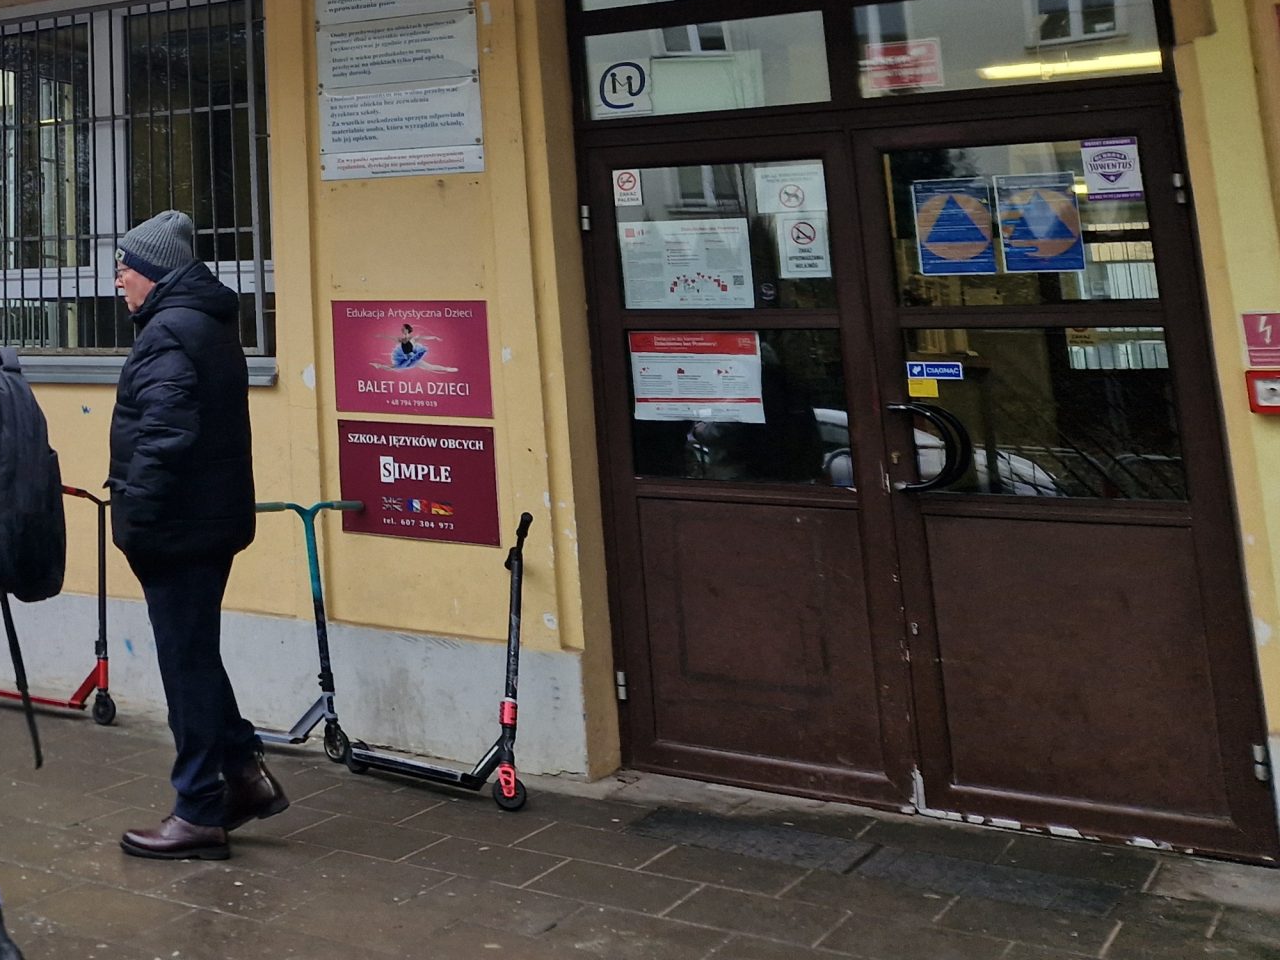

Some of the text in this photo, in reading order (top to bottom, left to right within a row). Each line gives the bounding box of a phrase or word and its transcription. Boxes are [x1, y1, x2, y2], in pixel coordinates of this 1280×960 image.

[1088, 161, 1133, 172] JUWENTUS
[346, 307, 473, 319] Edukacja Artystyczna Dzieci
[357, 380, 470, 396] BALET DLA DZIECI
[348, 433, 484, 450] SZKOŁA JĘZYKÓW OBCYCH
[382, 460, 452, 483] SIMPLE
[383, 517, 397, 525] tel.
[438, 522, 454, 530] 973
